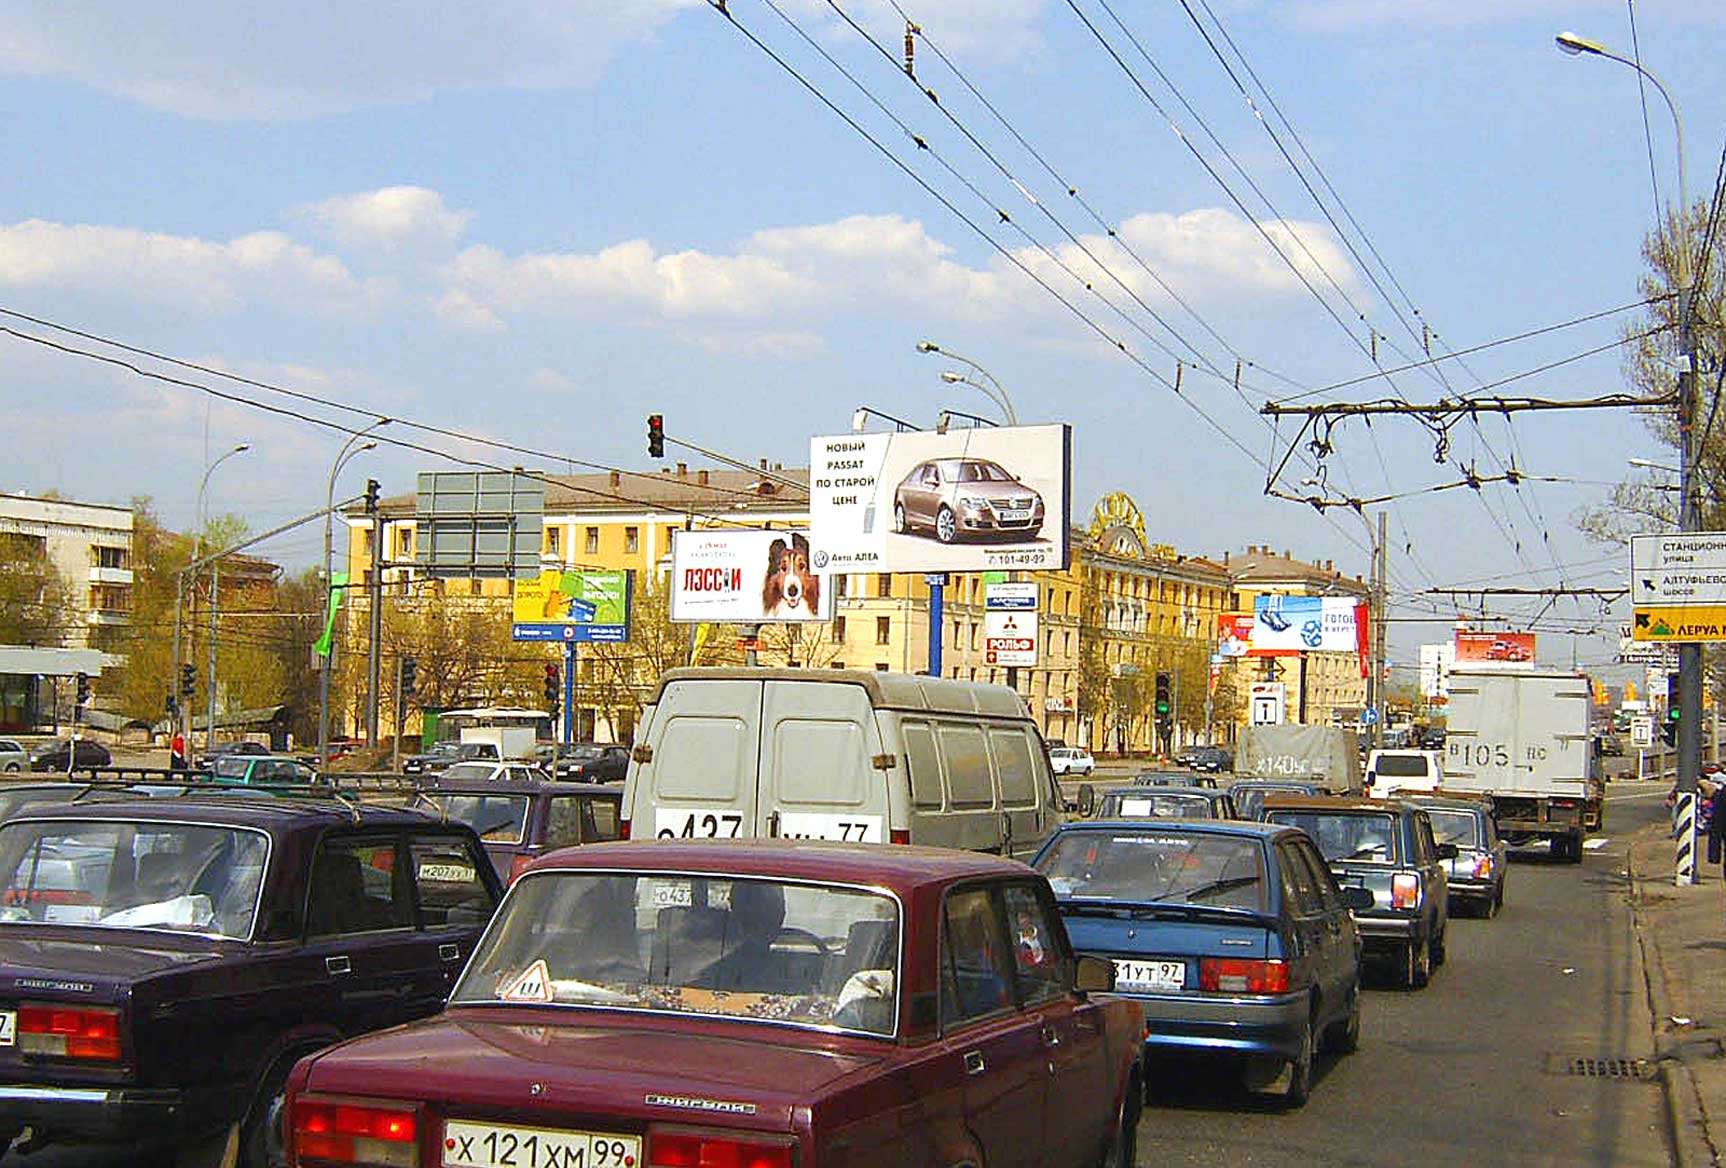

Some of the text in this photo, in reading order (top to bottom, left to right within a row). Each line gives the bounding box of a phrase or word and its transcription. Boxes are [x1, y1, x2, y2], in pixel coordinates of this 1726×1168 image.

[826, 441, 866, 452] НОВЫЙ
[827, 460, 864, 470] PASSAT
[816, 475, 875, 488] ПО СТАРОЙ
[832, 496, 858, 506] ЦЕНЕ
[1663, 556, 1694, 564] улица
[1678, 625, 1719, 636] ЛЕРУА
[989, 639, 1031, 650] РОЛЬФ
[1464, 744, 1509, 767] 105
[1161, 964, 1179, 978] 97
[594, 1140, 626, 1166] 99
